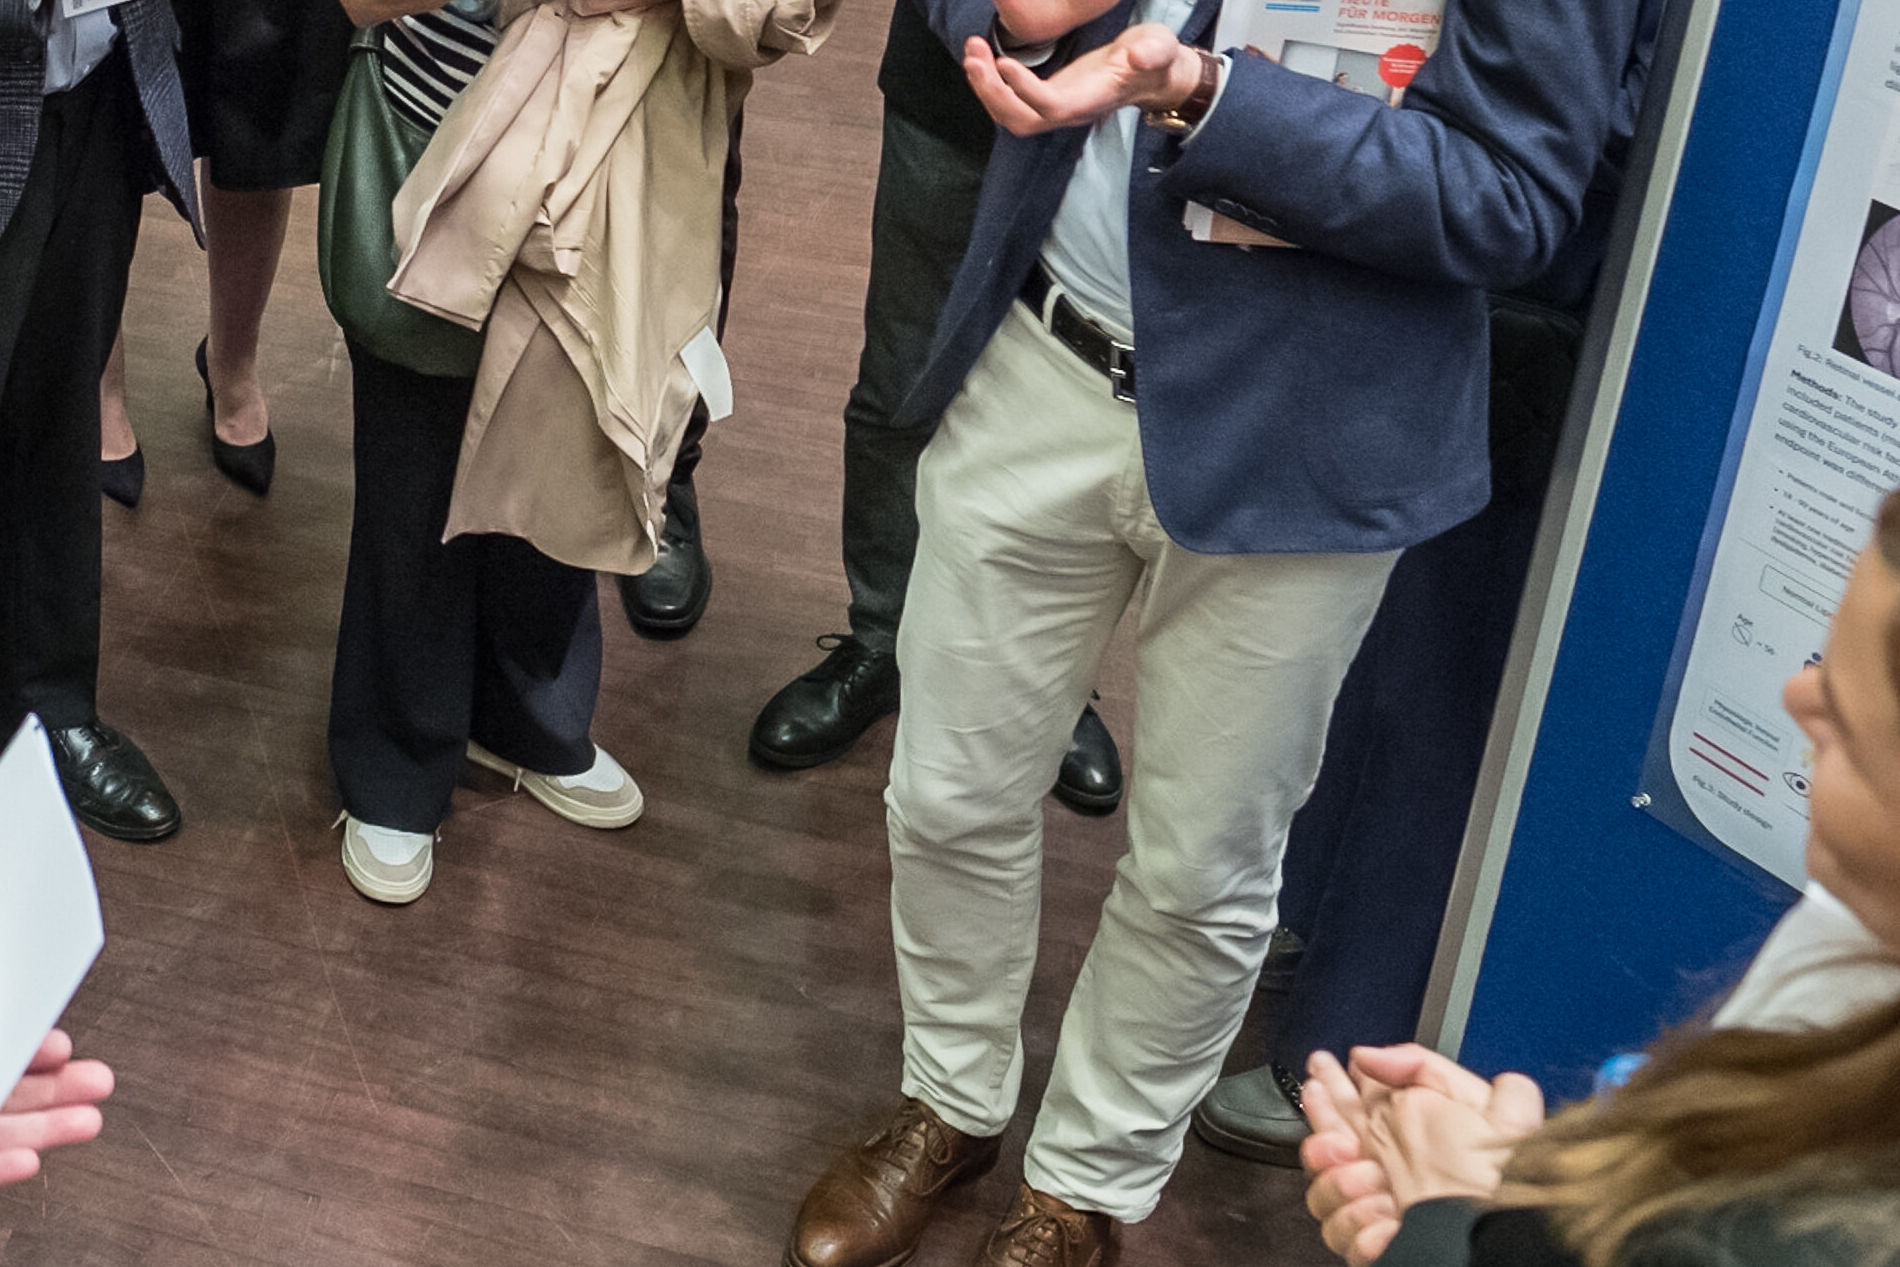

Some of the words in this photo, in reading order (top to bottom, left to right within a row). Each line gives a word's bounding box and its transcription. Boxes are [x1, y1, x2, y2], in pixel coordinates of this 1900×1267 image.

[1338, 6, 1368, 19] FÜR
[1372, 10, 1441, 24] MORGEN
[1786, 386, 1833, 415] included
[1791, 369, 1842, 401] Methods:
[1846, 395, 1865, 412] The
[1867, 408, 1898, 429] study
[1782, 401, 1861, 445] cardiovascular
[1775, 433, 1821, 462] endpoint
[1808, 432, 1826, 446] the
